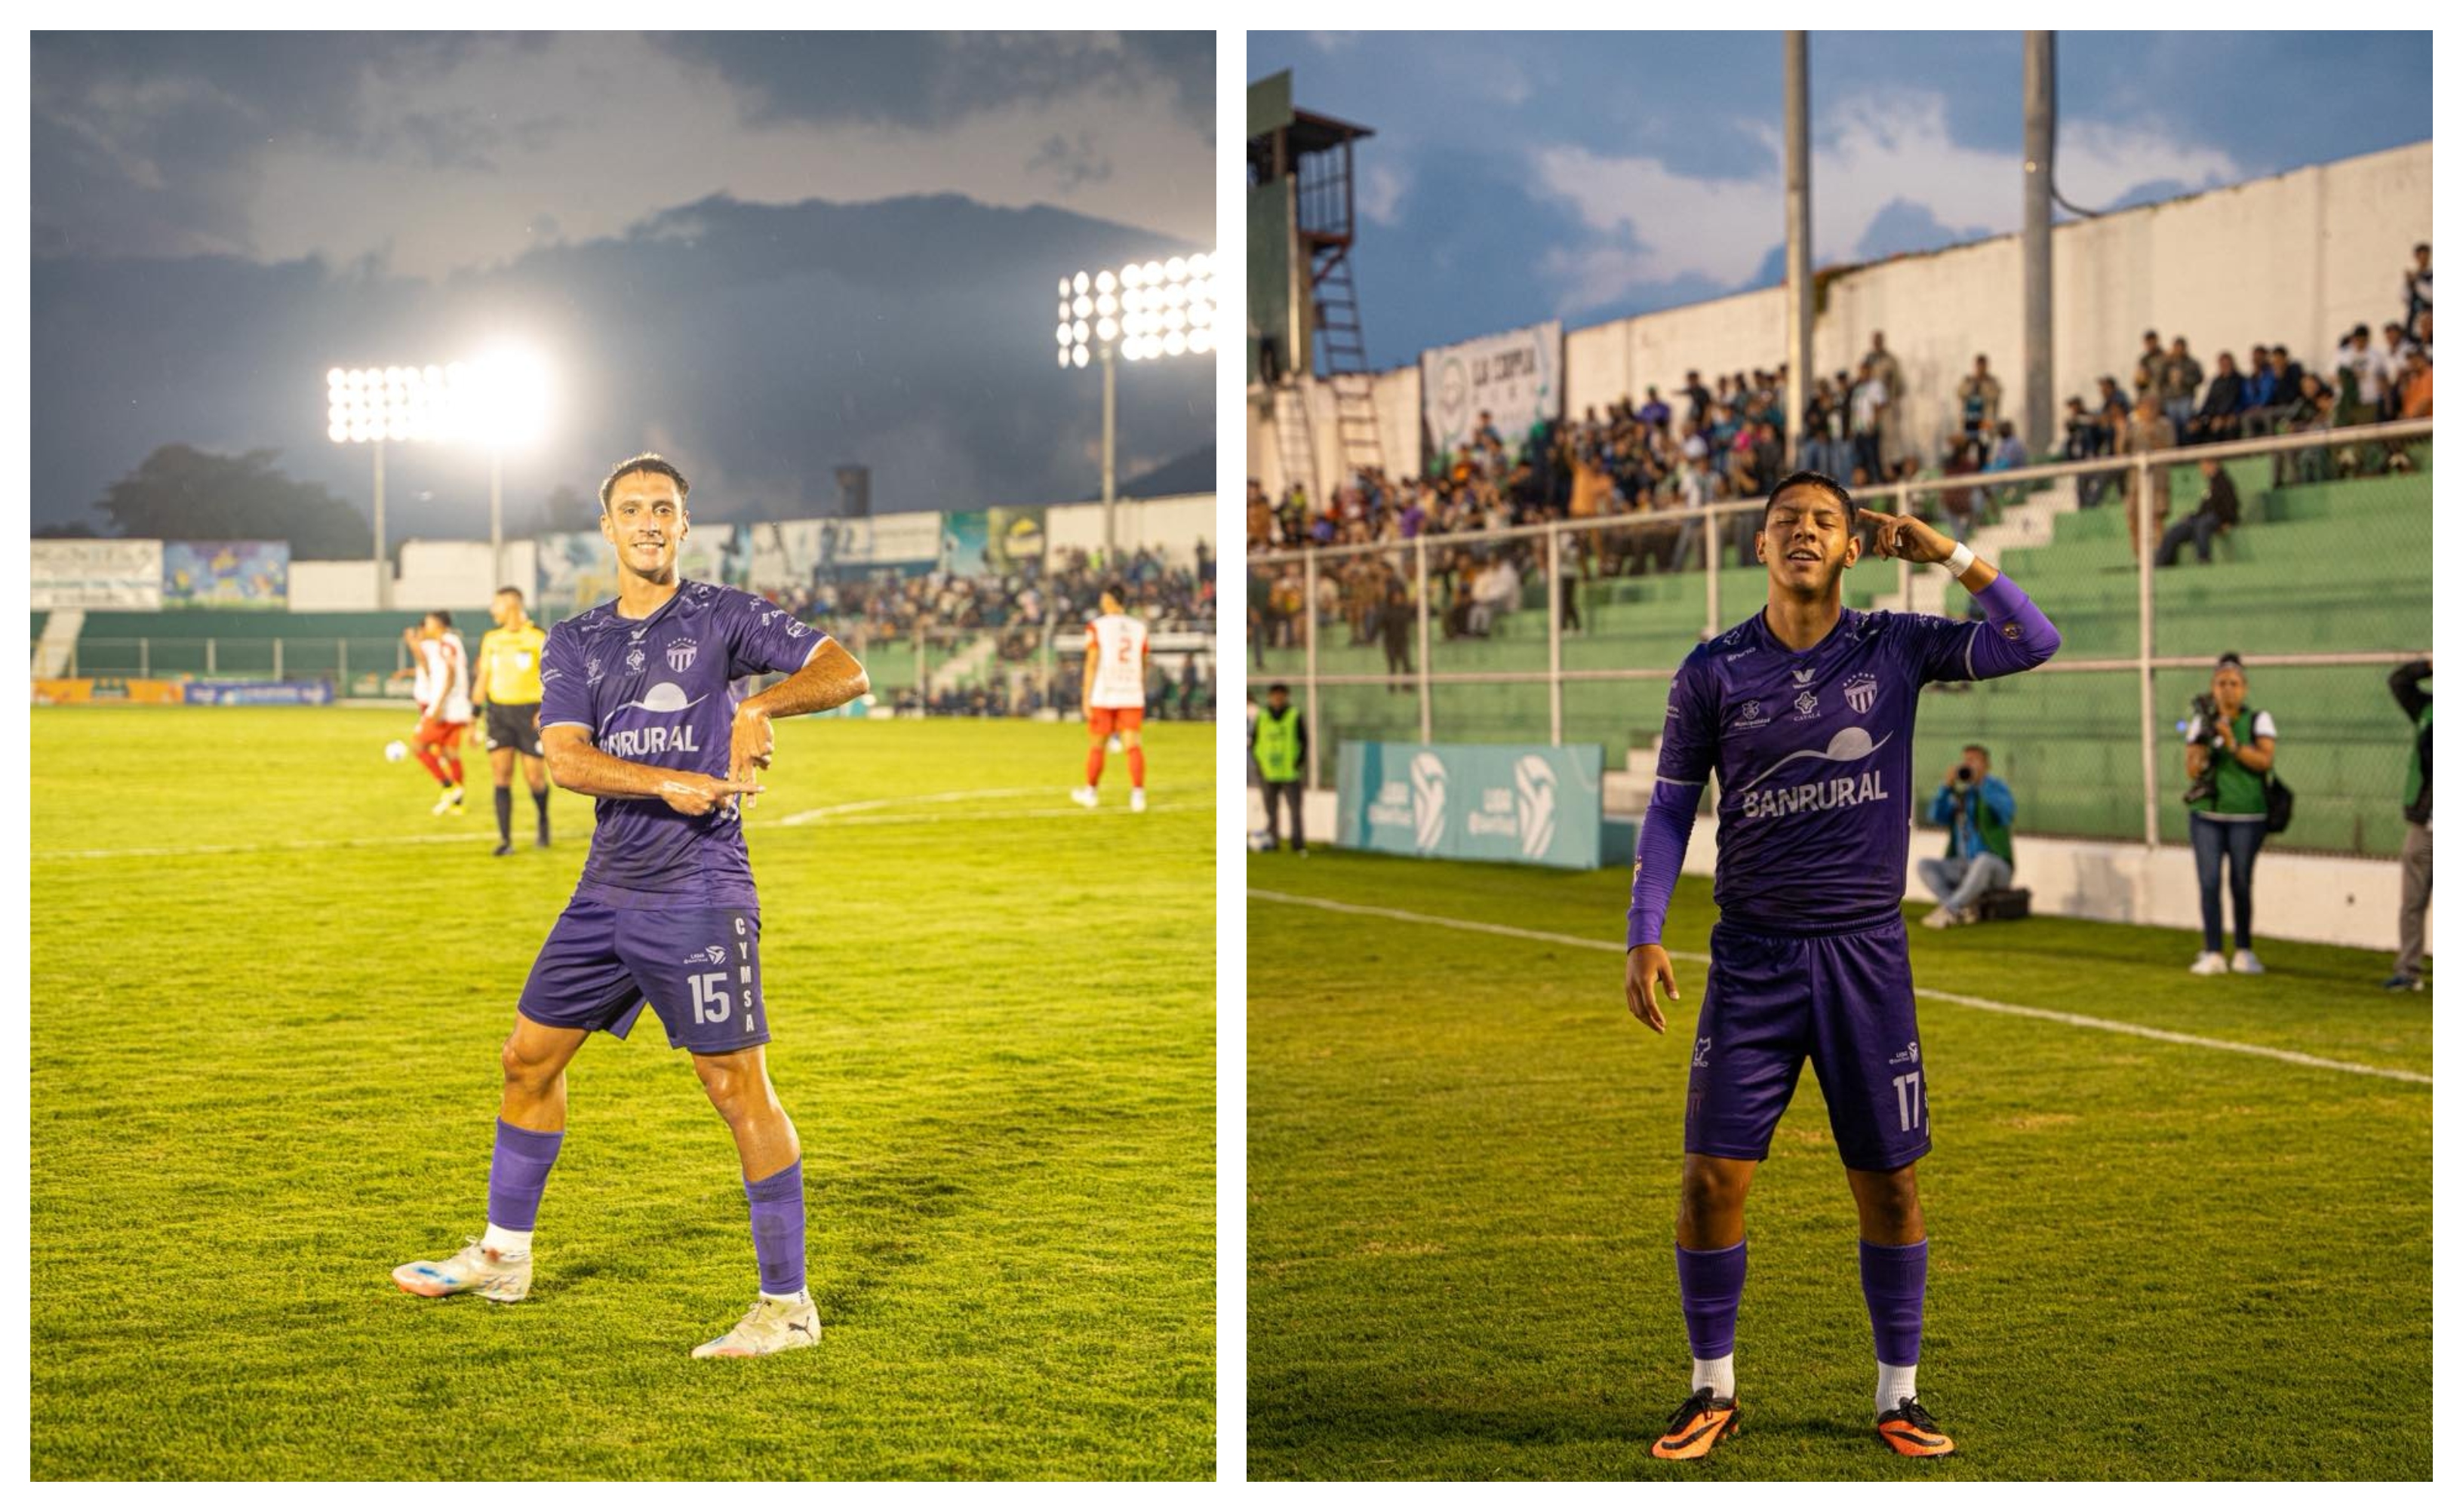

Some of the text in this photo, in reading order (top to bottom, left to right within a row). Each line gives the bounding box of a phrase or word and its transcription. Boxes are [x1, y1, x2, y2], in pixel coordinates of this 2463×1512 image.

[1118, 637, 1133, 665] 2
[1742, 770, 1889, 818] BANRURAL
[687, 972, 730, 1024] 15
[735, 917, 755, 1032] CYMSA
[1893, 1071, 1919, 1132] 17
